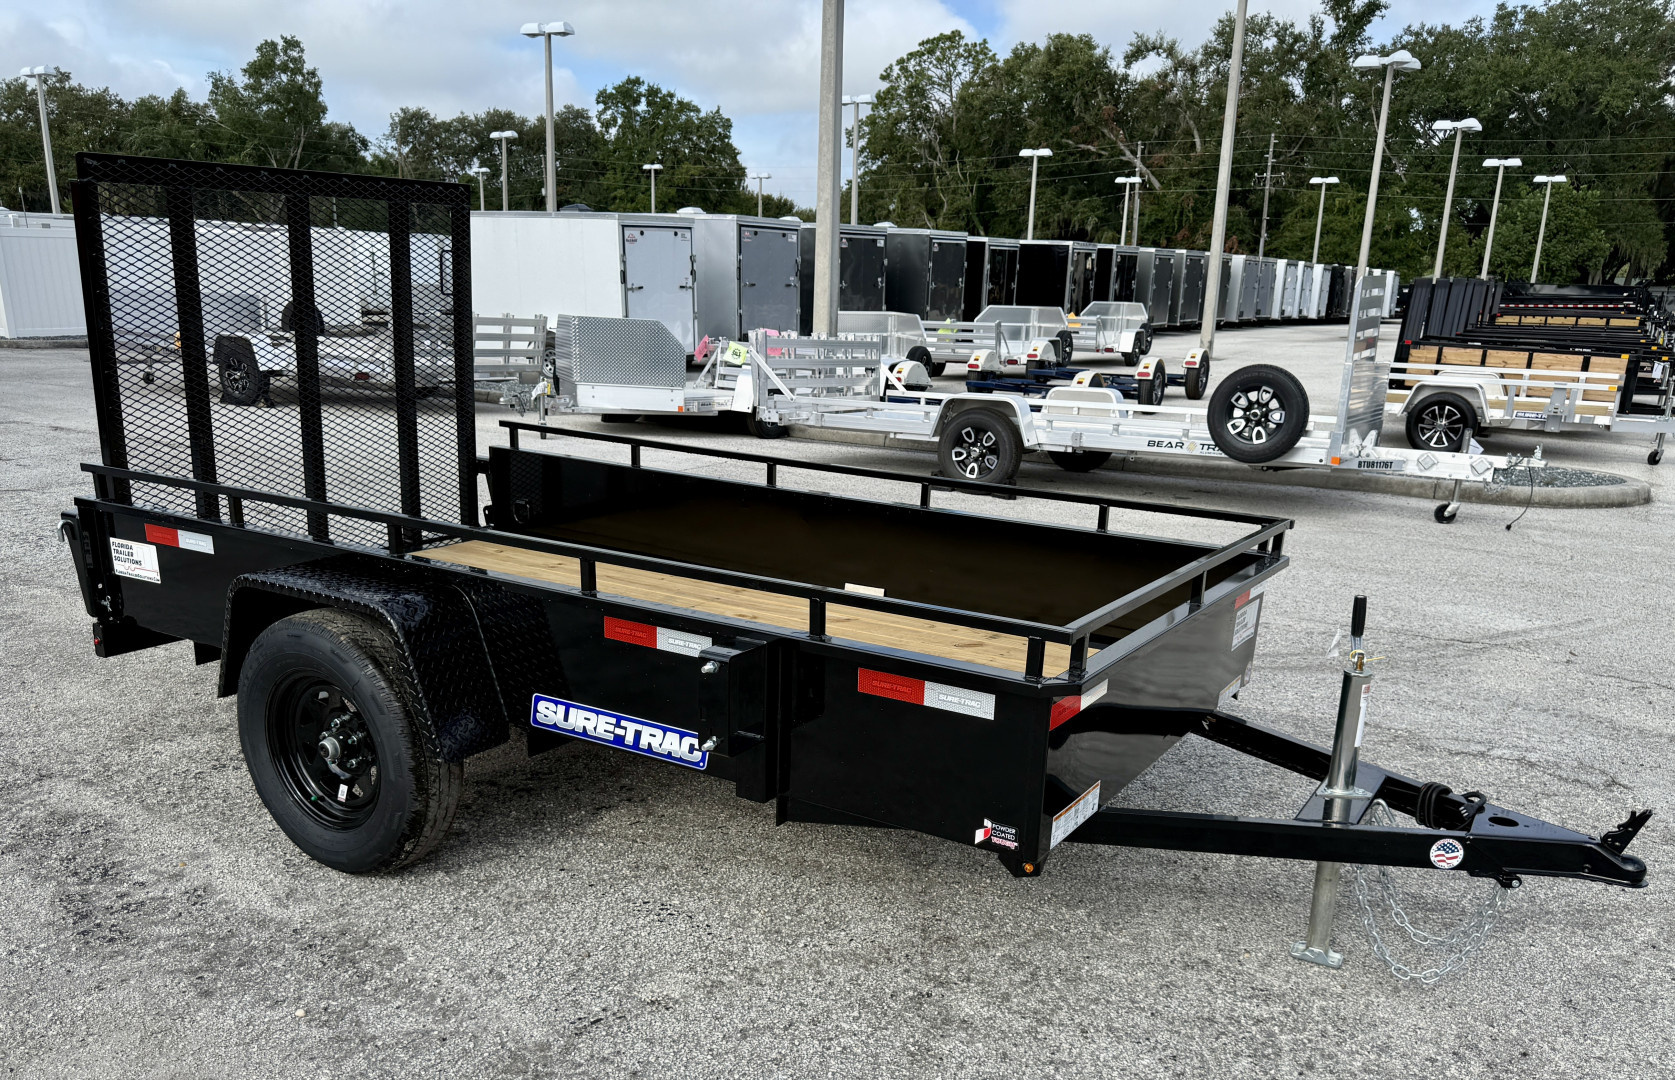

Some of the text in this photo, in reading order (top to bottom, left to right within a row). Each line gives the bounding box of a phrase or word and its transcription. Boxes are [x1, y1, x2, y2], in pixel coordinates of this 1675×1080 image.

[1147, 440, 1184, 449] BEAR
[1357, 460, 1394, 469] BTU81176T
[112, 541, 133, 550] FLORIDA
[113, 549, 133, 557] TRAILER
[114, 556, 142, 565] SOLUTIONS
[614, 626, 647, 638] SURE-TRAC
[668, 637, 702, 650] SURE-TRAC
[872, 680, 912, 693] SURE-TRAC
[938, 693, 981, 708] SURE-TRAC
[536, 700, 702, 763] SURE-TRAC
[992, 823, 1016, 835] POWDER
[991, 830, 1016, 841] COATED
